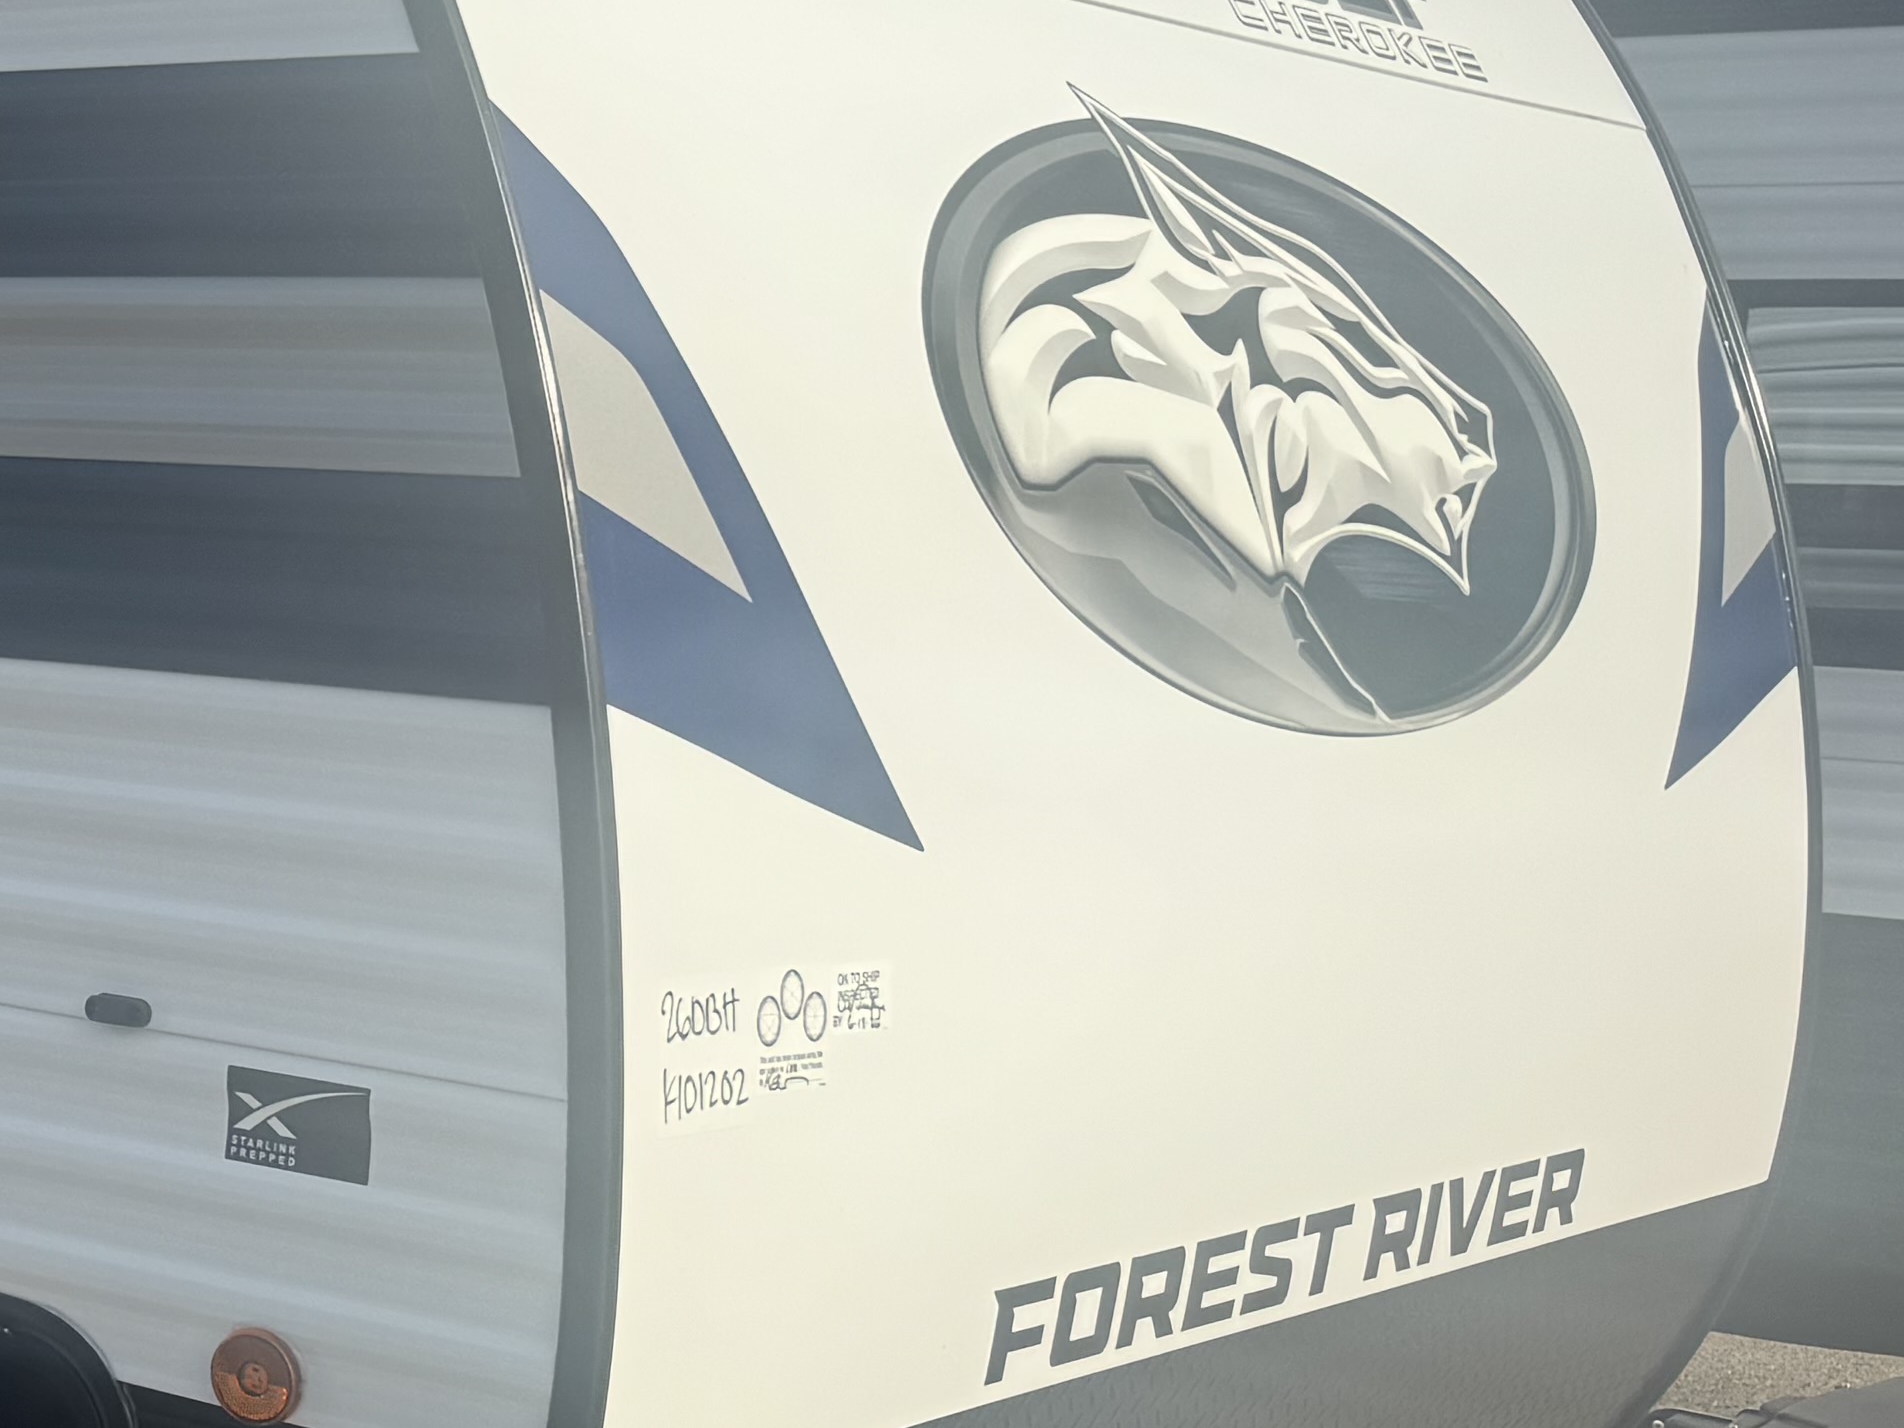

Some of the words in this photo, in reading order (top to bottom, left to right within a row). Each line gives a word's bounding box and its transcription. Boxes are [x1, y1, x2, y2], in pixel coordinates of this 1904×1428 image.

[660, 987, 740, 1044] 260BH
[230, 1146, 296, 1167] PREPPED
[231, 1134, 297, 1155] STARLINK
[983, 1203, 1356, 1386] FOREST
[1363, 1148, 1586, 1281] RIVER
